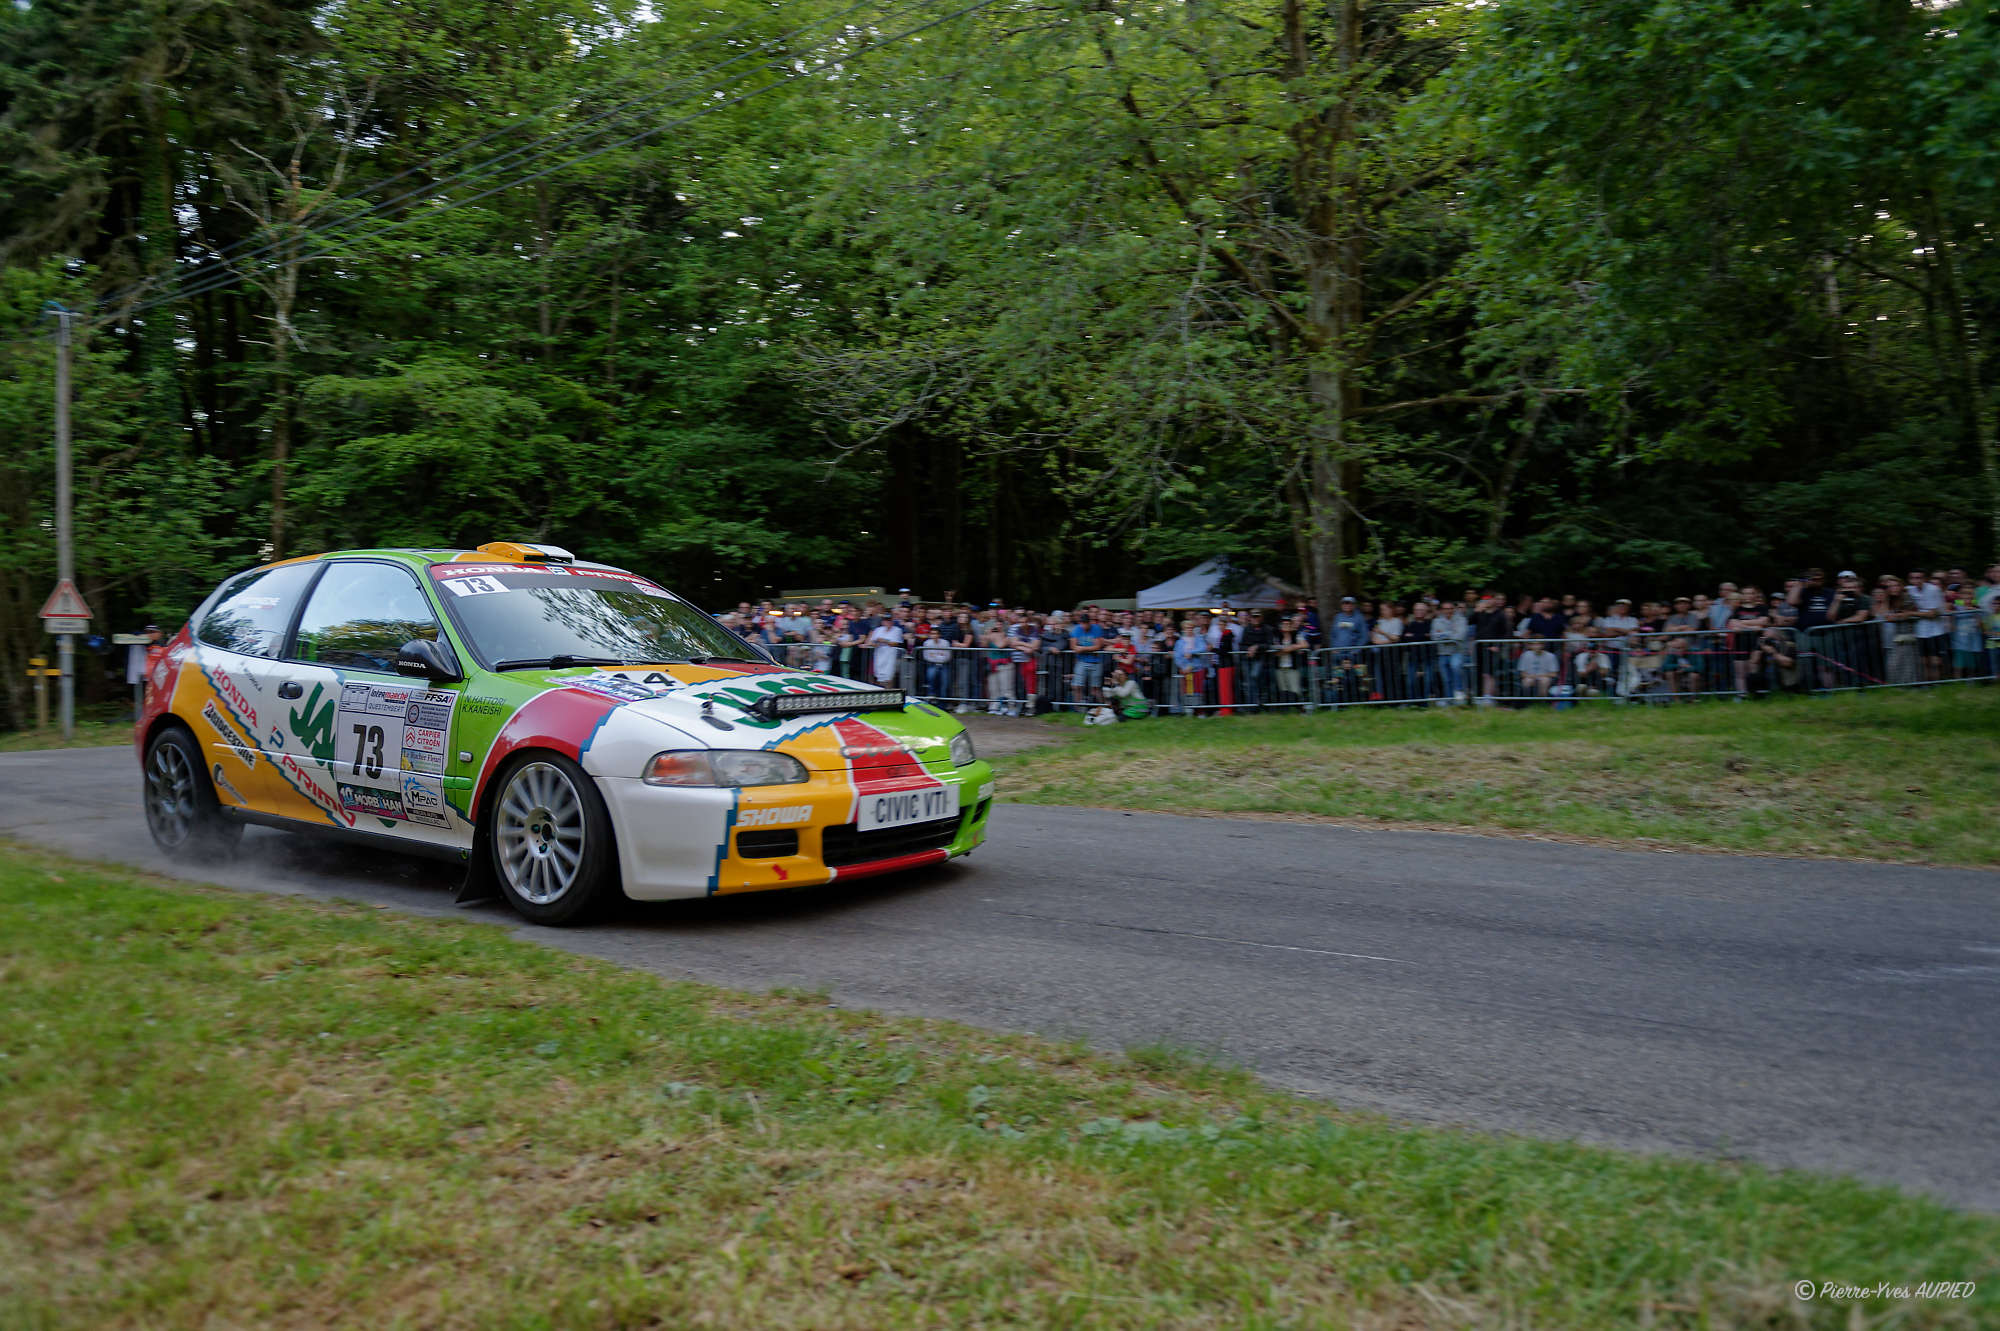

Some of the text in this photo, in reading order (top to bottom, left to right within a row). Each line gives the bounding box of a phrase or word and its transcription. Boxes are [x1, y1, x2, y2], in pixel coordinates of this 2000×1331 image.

[442, 566, 546, 576] HONDA
[456, 578, 494, 594] 73
[398, 660, 427, 669] HONDA
[212, 664, 257, 728] HONDA
[424, 693, 448, 704] FFSA
[353, 723, 385, 780] 73
[736, 804, 814, 827] SHOWA
[875, 794, 919, 824] CIVIC
[923, 790, 948, 818] VTI
